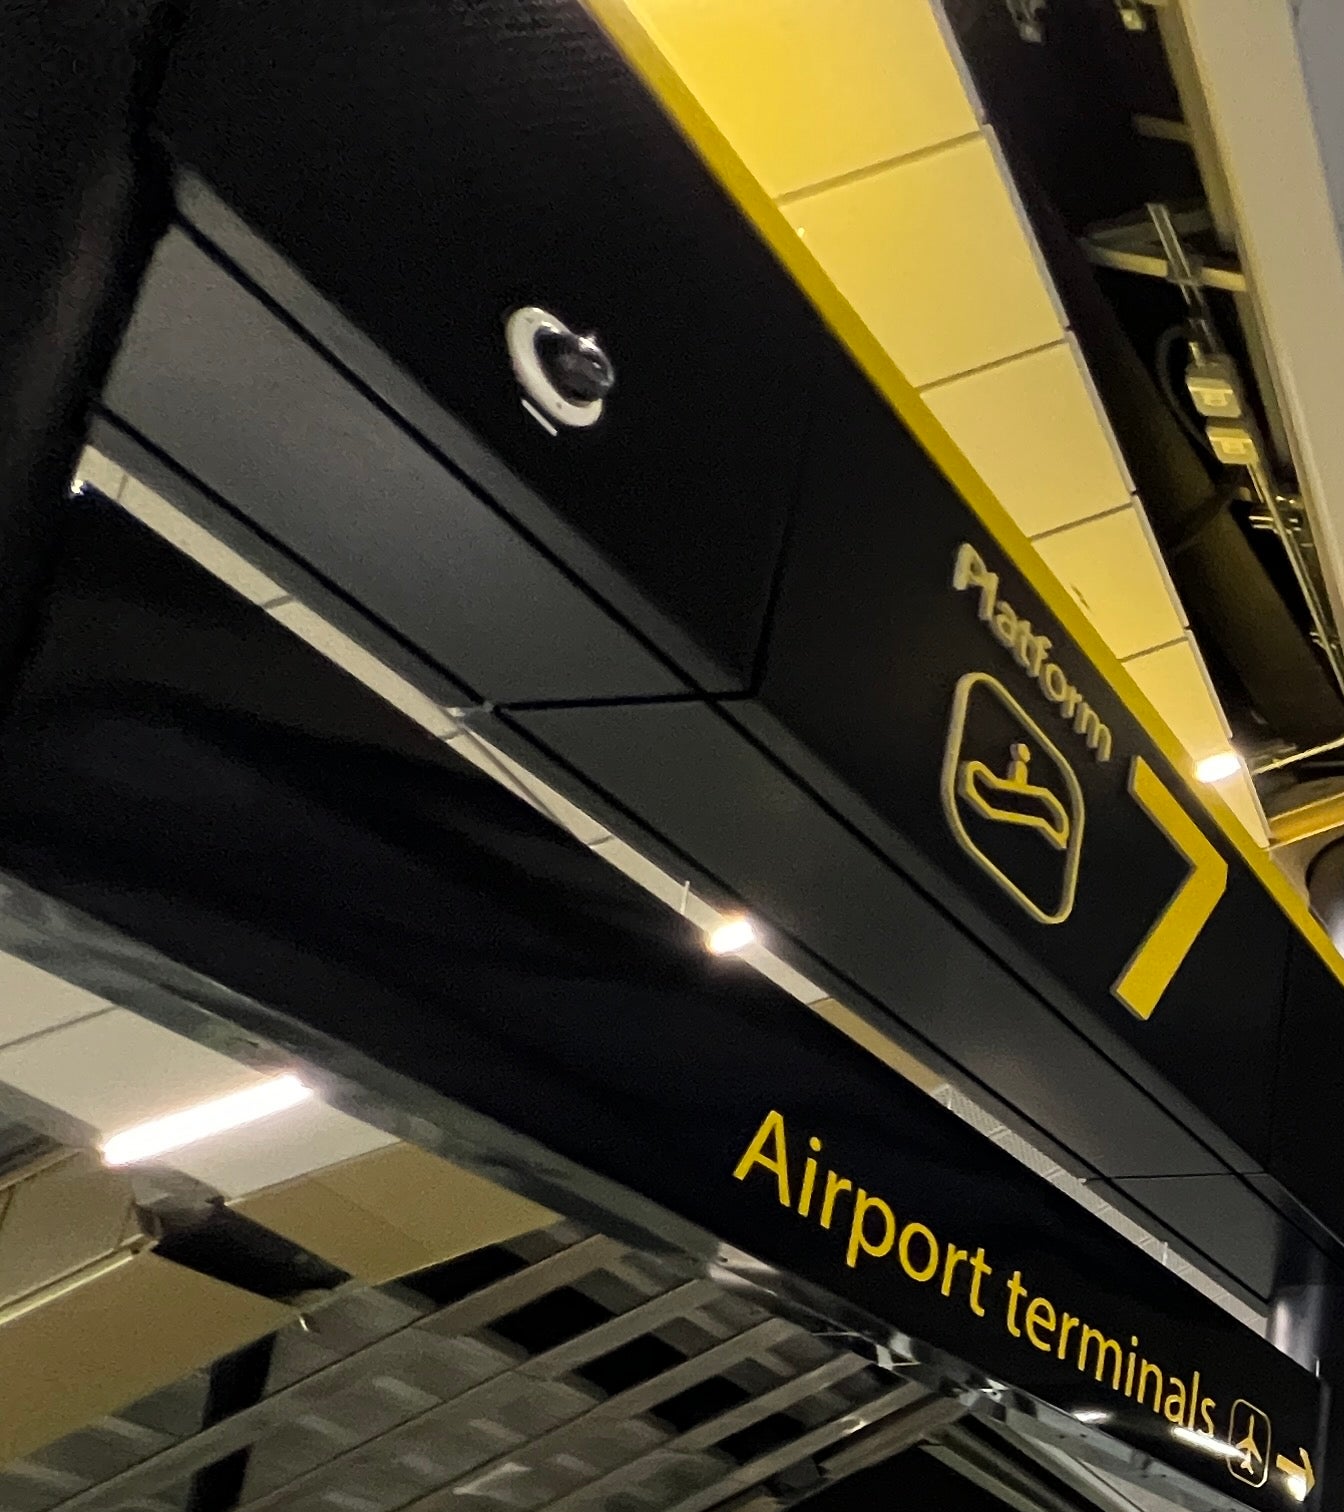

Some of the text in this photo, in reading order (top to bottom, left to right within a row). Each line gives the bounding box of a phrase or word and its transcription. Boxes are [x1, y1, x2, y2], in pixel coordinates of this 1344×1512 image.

[953, 543, 1112, 762] Platform
[1109, 755, 1229, 1020] 7
[732, 1110, 1216, 1438] Airport terminals
